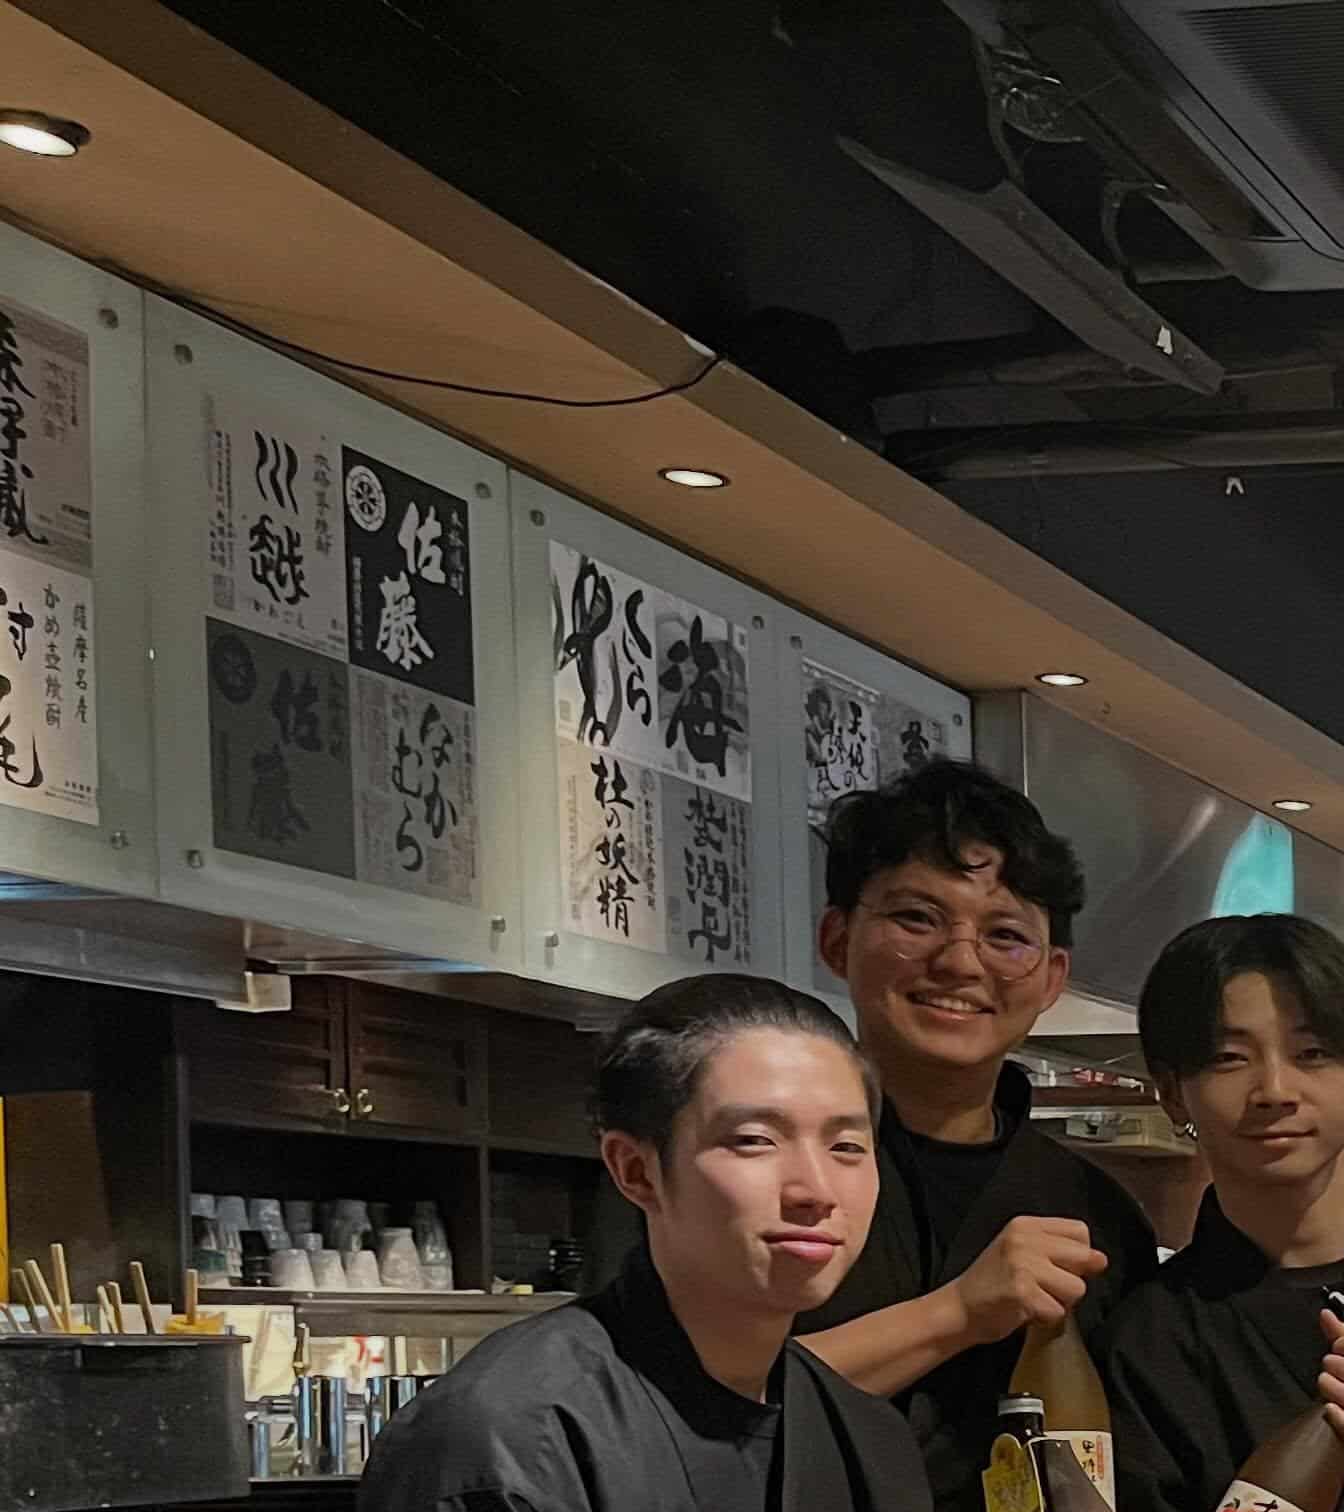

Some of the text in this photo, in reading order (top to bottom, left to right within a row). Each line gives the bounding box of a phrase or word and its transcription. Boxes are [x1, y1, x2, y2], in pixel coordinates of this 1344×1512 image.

[376, 501, 446, 672] 佐藤
[591, 756, 640, 938] 杜の妖精
